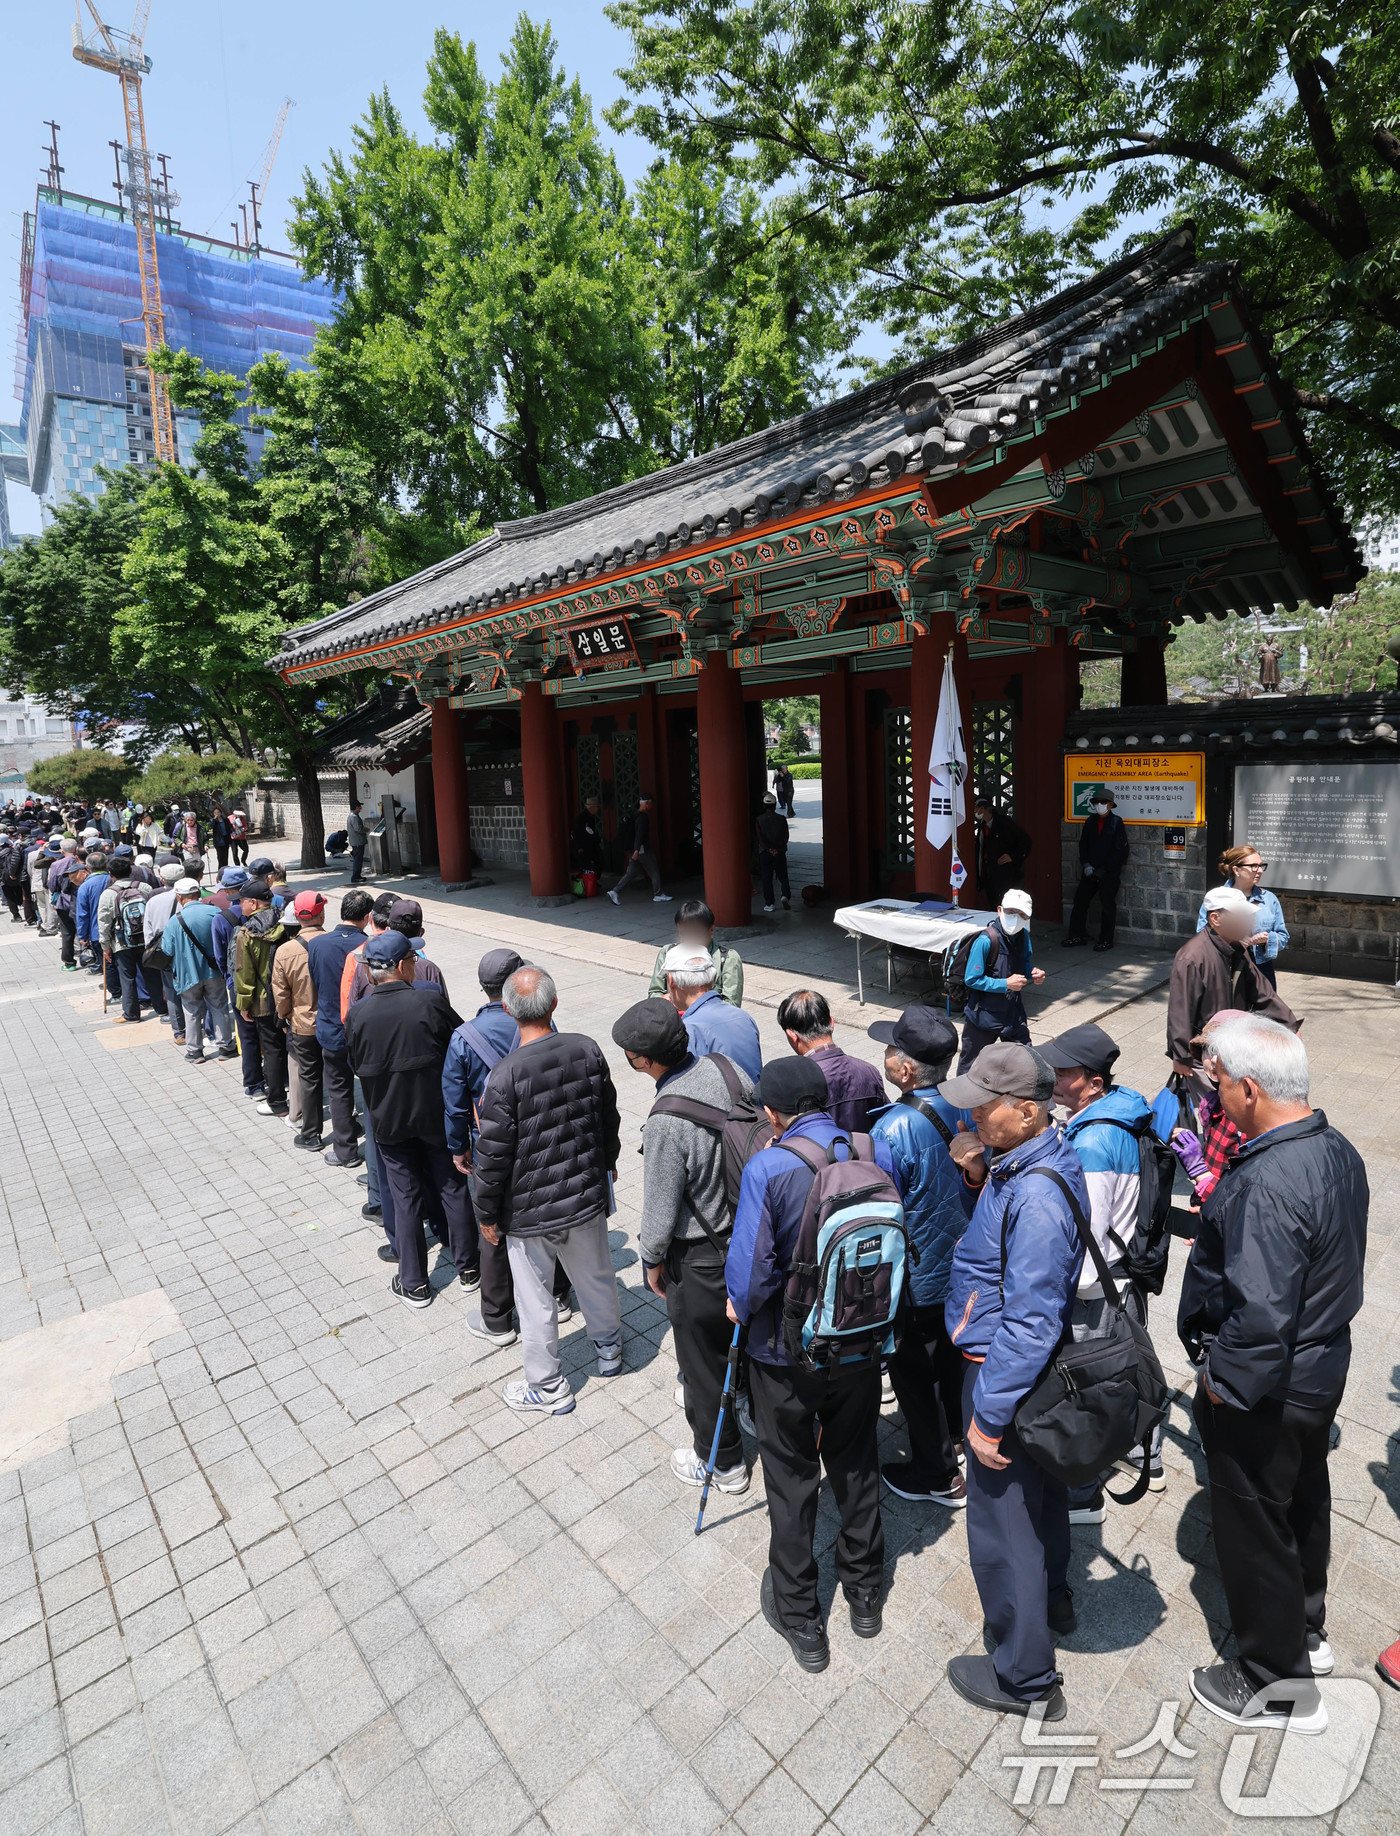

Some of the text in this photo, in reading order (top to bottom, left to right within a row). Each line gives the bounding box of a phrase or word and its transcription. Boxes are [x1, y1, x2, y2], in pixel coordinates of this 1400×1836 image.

[577, 625, 626, 655] 삼일문
[1095, 758, 1170, 768] 지진 옥외대피장소
[1288, 775, 1341, 783] 공원이용 안내문
[1172, 835, 1184, 844] 99
